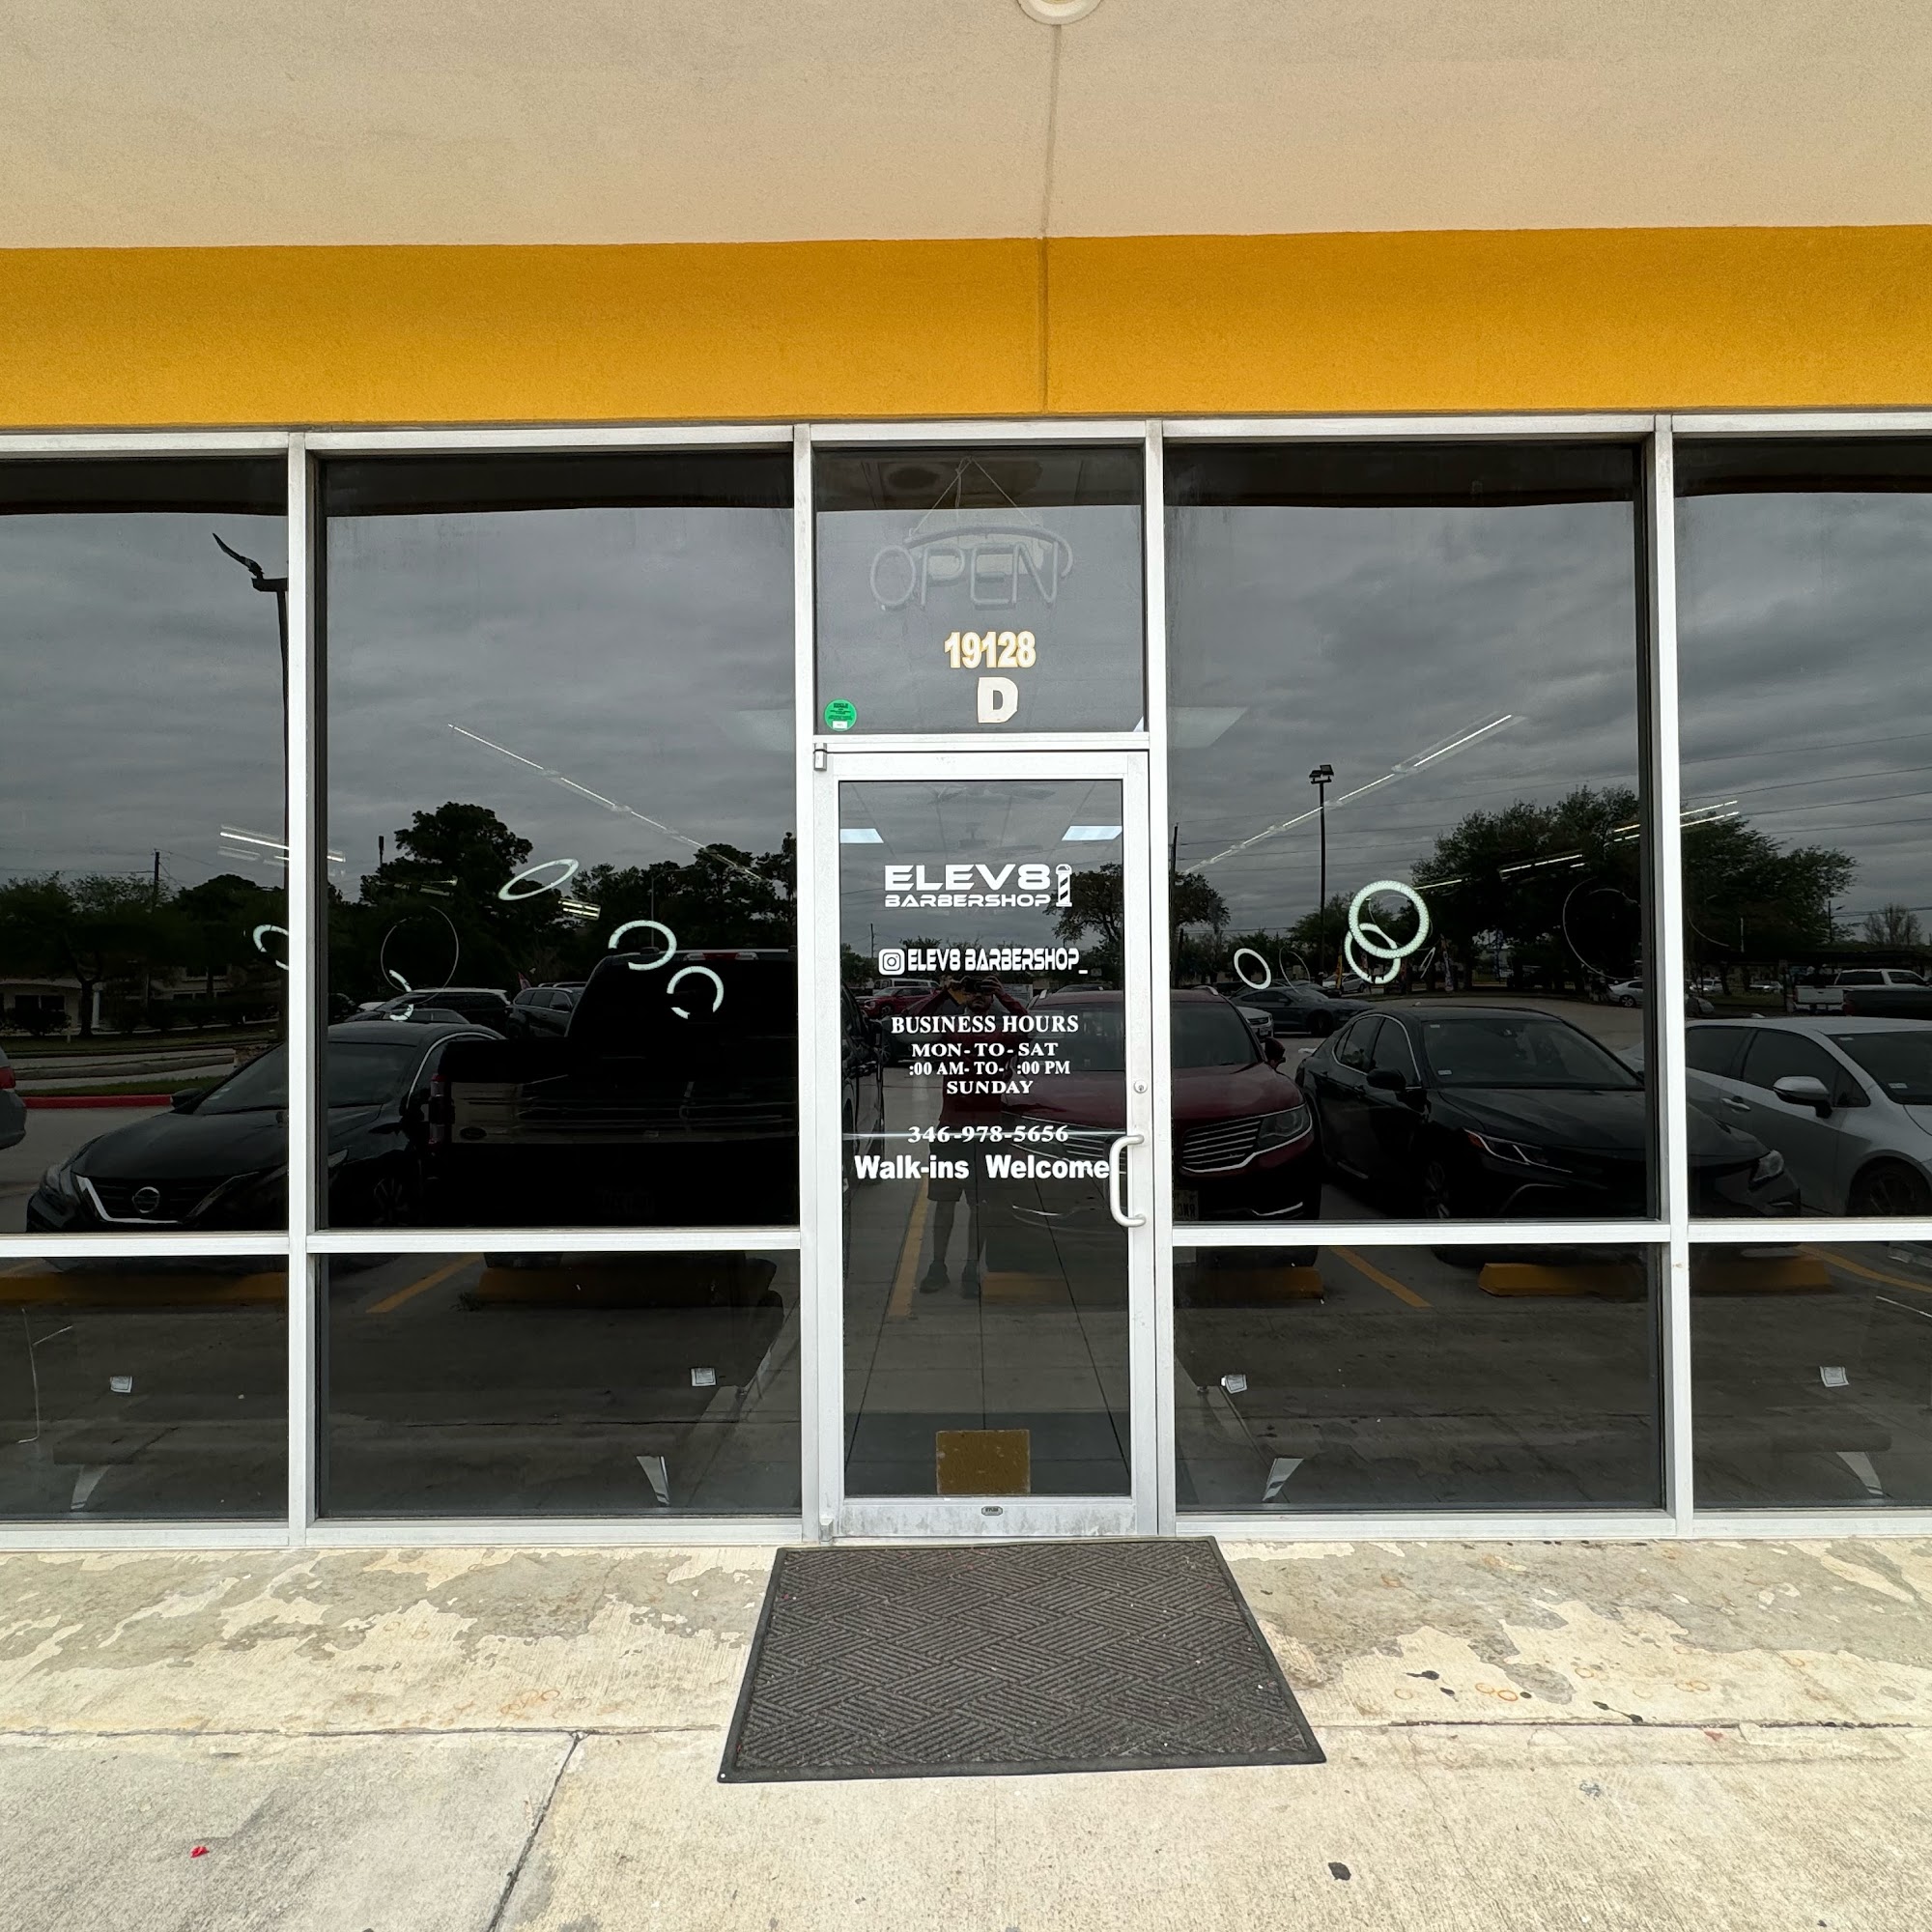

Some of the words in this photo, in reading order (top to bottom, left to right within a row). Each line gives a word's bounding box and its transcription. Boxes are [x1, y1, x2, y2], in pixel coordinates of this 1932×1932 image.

[870, 541, 1058, 607] OPEN
[944, 630, 1037, 668] 19128
[977, 676, 1018, 724] D
[885, 864, 1050, 891] ELEV8
[885, 895, 1050, 907] BARBERSHOP
[907, 949, 961, 972] ELEV8
[891, 1015, 996, 1034] BUSINESS
[1002, 1014, 1079, 1033] HOURS
[1017, 1042, 1059, 1057] SAT
[909, 1062, 932, 1076] :00
[1017, 1061, 1039, 1075] :00
[1044, 1060, 1070, 1075] PM
[947, 1080, 1034, 1094] SUNDAY
[907, 1124, 1069, 1144] 346-978-5656
[854, 1154, 970, 1179] Walk-ins
[985, 1154, 1110, 1179] Welcome
